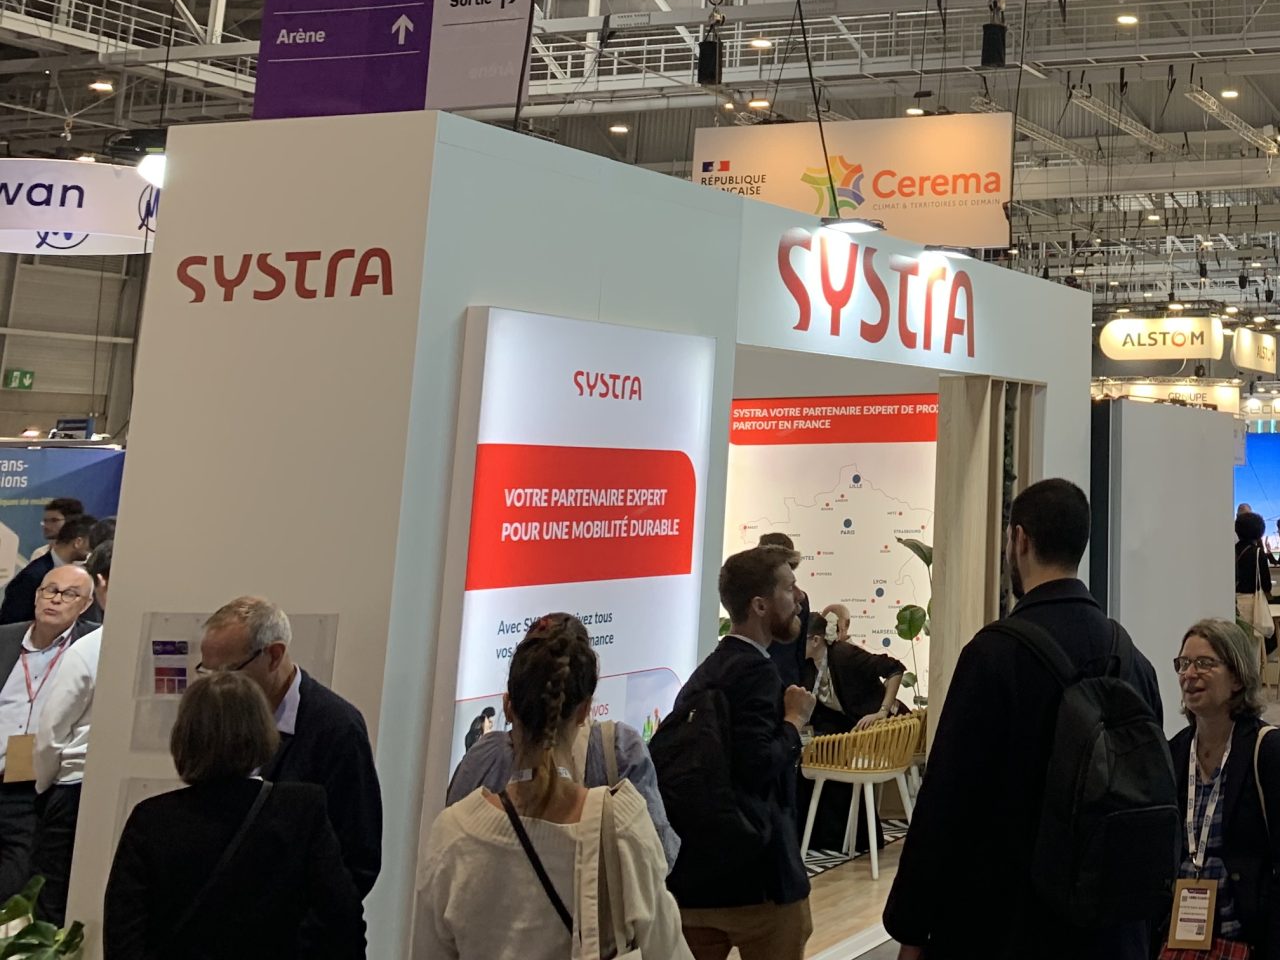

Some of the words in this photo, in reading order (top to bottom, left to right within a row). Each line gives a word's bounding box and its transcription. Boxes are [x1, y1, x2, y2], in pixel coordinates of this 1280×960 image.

[276, 28, 325, 45] Arène
[701, 174, 766, 185] RÉPUBLIQUE
[872, 169, 1001, 198] Cerema
[176, 247, 393, 304] SYSTRA
[777, 227, 975, 358] SYSTRA
[1122, 330, 1205, 348] ALSTOM
[573, 370, 642, 401] SYSTRA
[734, 408, 768, 418] SYSTRA
[769, 407, 801, 417] VOTRE
[802, 406, 861, 416] PARTENAIRE
[863, 405, 899, 415] EXPERT
[901, 405, 914, 414] DE
[733, 421, 777, 430] PARTOUT
[778, 420, 792, 429] EN
[794, 419, 830, 429] FRANCE
[504, 488, 549, 507] VOTRE
[551, 488, 625, 507] PARTENAIRE
[626, 488, 667, 506] EXPERT
[501, 522, 540, 541] POUR
[543, 521, 569, 540] UNE
[571, 516, 628, 539] MOBILITÉ
[630, 519, 680, 537] DURABLE
[497, 620, 521, 635] Avec
[595, 612, 613, 624] tous
[496, 647, 512, 659] vos
